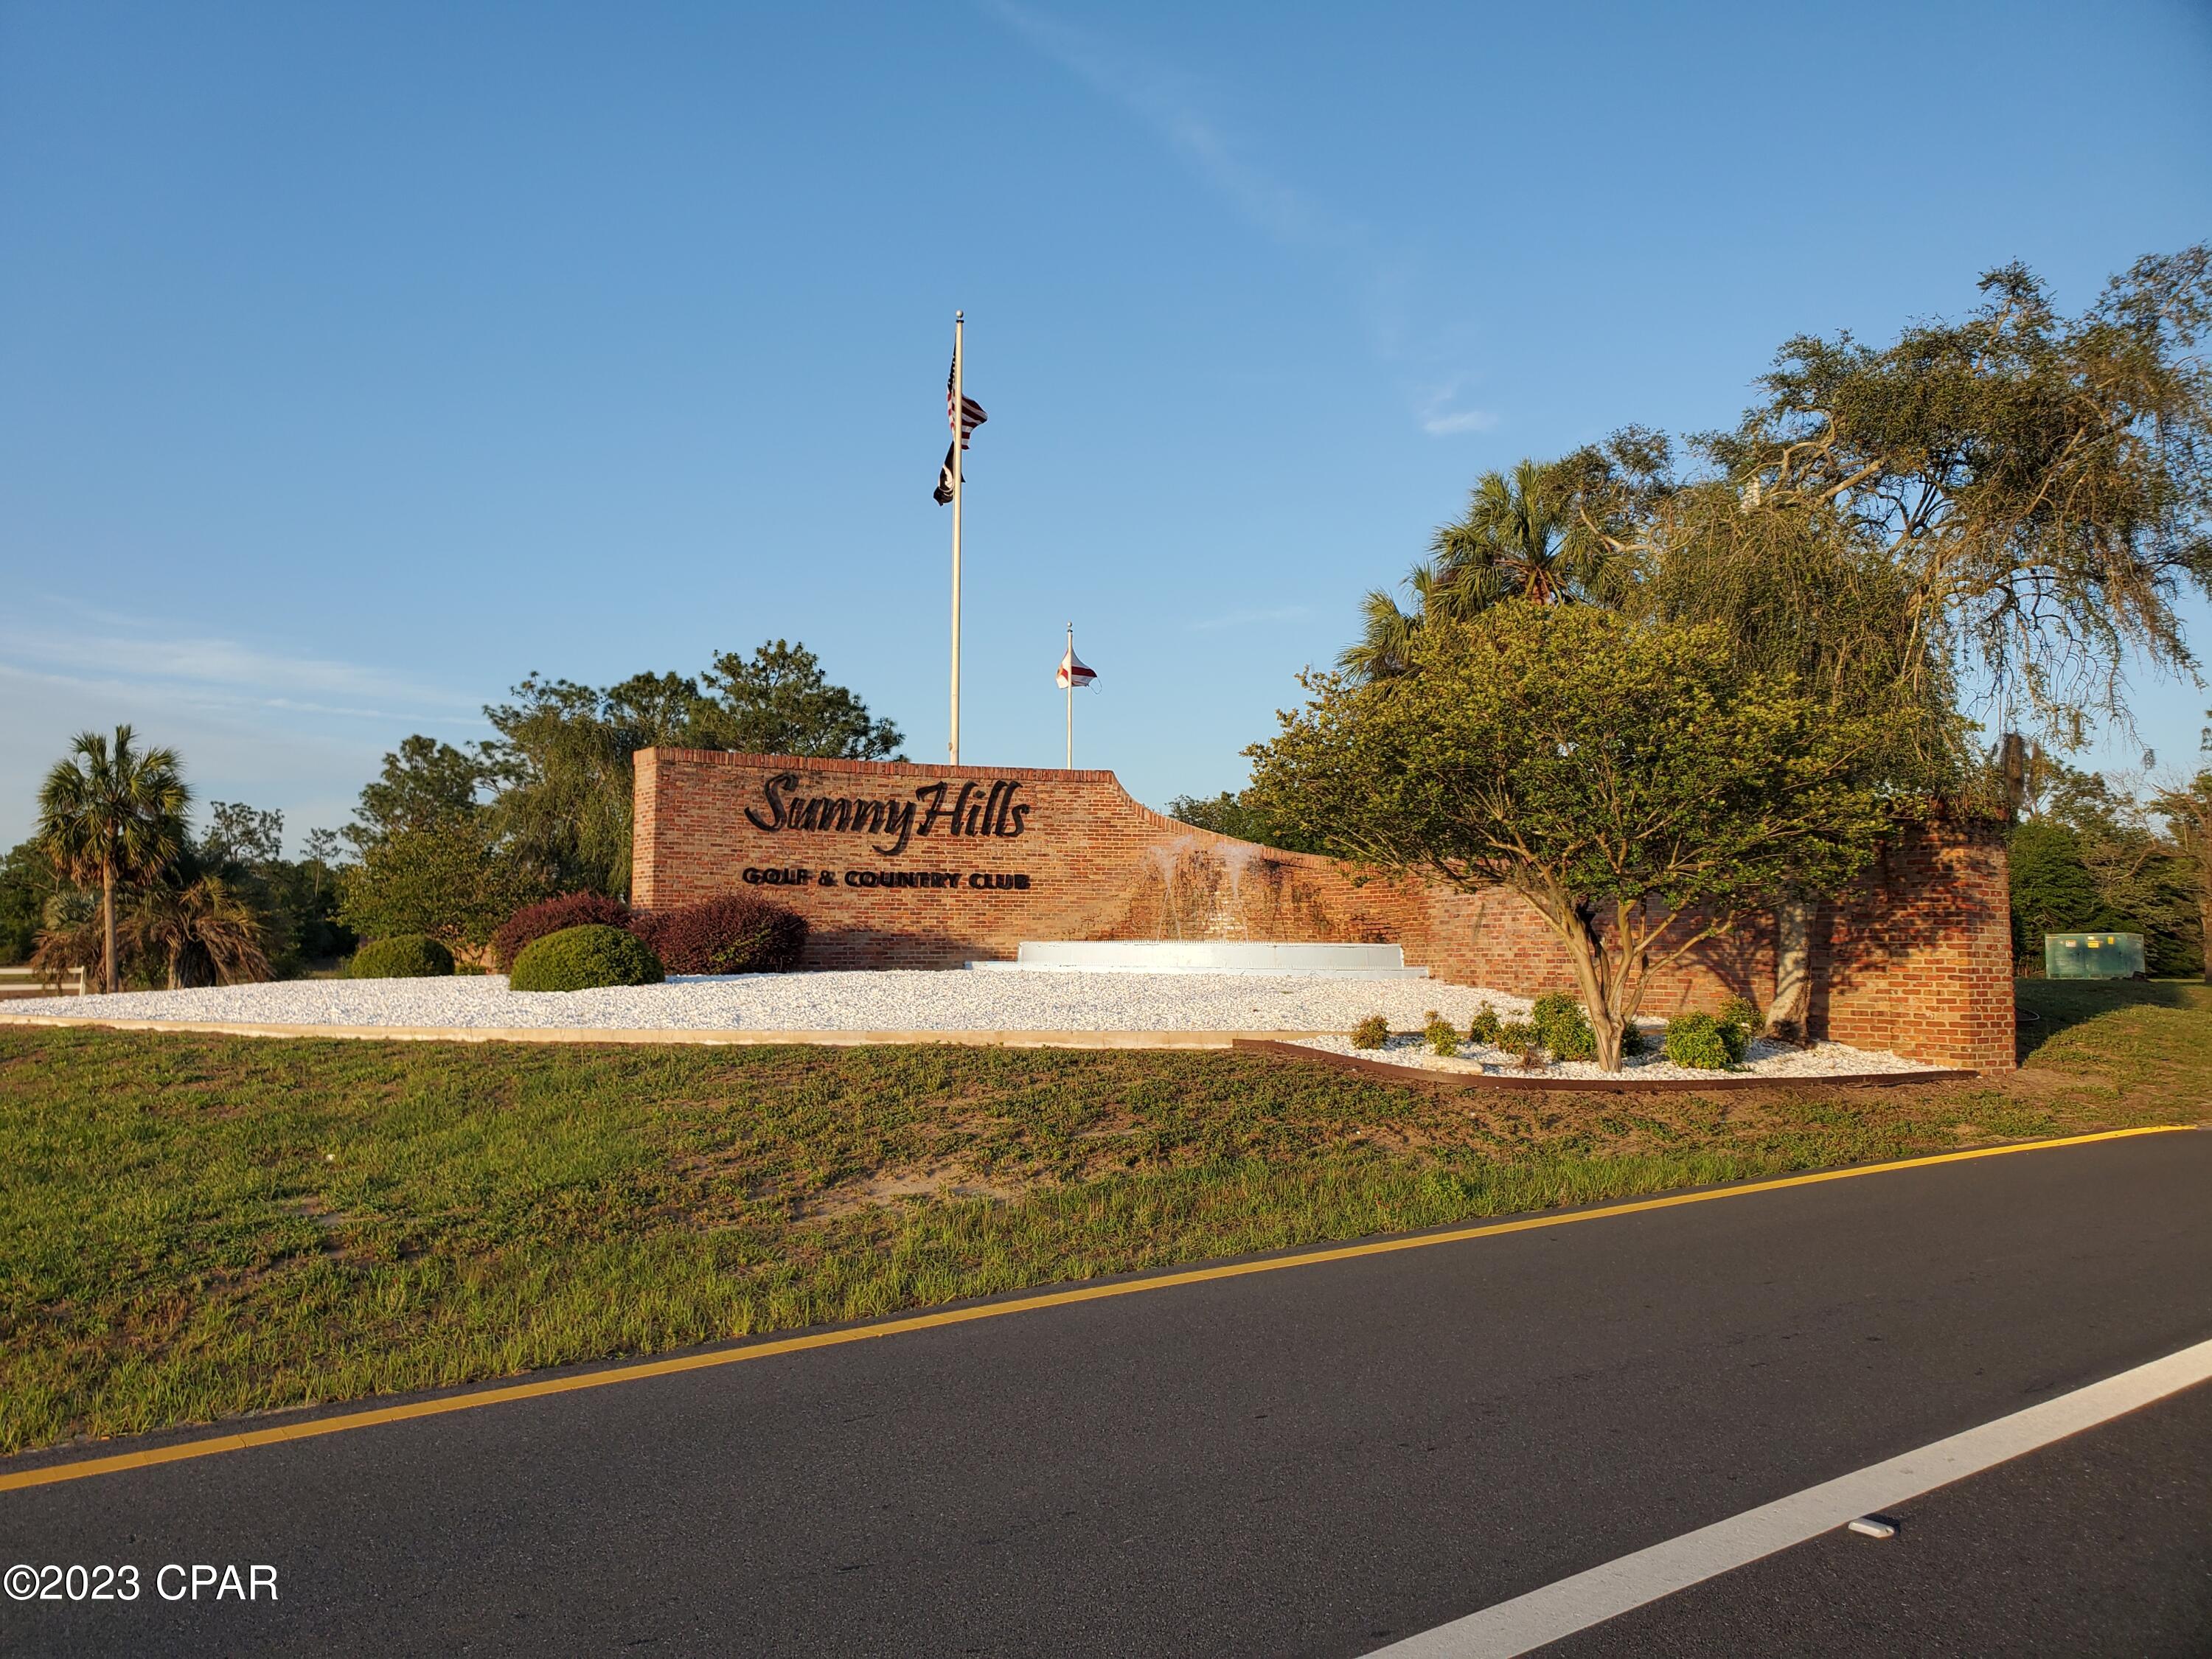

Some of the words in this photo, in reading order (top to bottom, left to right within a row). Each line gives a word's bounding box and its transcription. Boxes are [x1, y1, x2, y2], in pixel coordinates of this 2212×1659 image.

[745, 773, 917, 855] Sunny
[916, 779, 1031, 838] Hills
[742, 867, 811, 885] GOLF
[818, 870, 837, 886] &
[844, 870, 961, 888] COUNTRY
[969, 872, 1031, 890] CLUB
